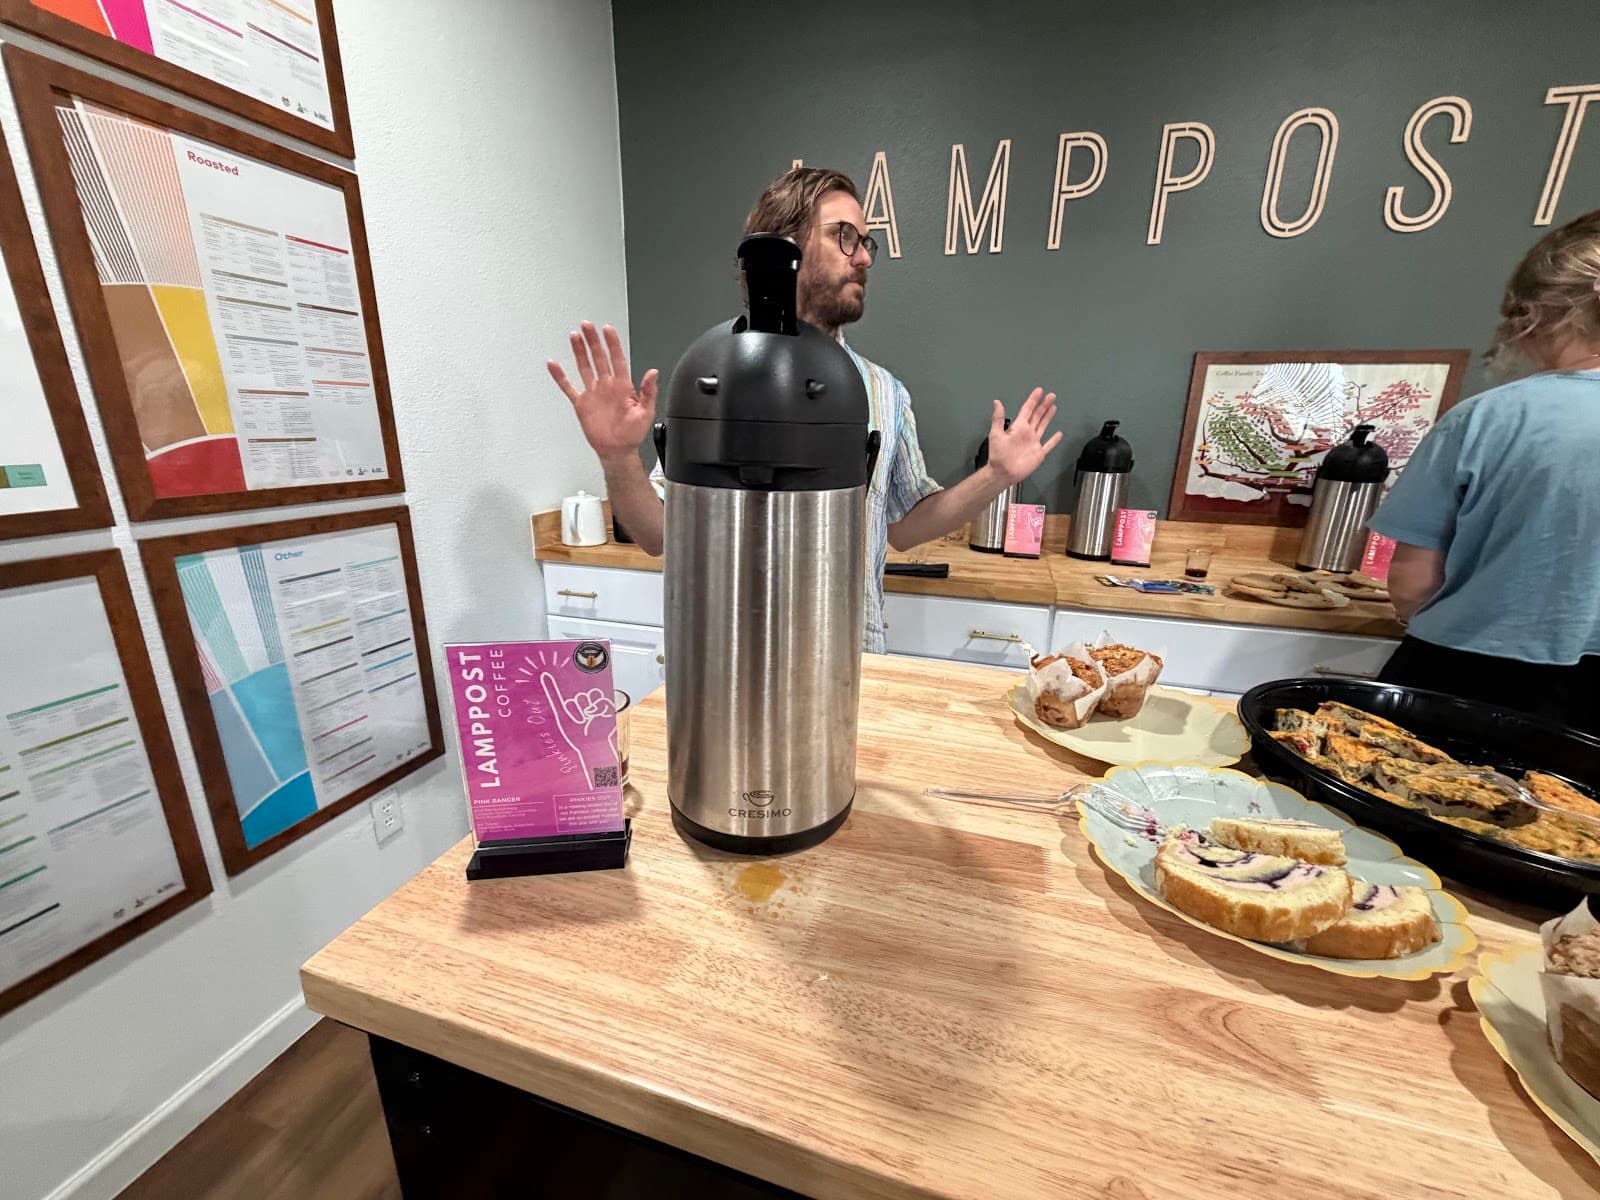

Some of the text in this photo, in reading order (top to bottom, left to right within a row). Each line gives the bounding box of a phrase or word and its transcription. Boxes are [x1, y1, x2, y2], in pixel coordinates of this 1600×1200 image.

[187, 150, 239, 177] Roasted
[793, 85, 1600, 258] AMPPOST
[1116, 511, 1127, 546] LAMPPOST
[274, 550, 304, 562] Other
[1366, 531, 1381, 565] LAMPPO
[490, 649, 512, 718] COFFEE
[459, 651, 501, 788] LAMPPOST
[728, 808, 792, 819] CRESIMO
